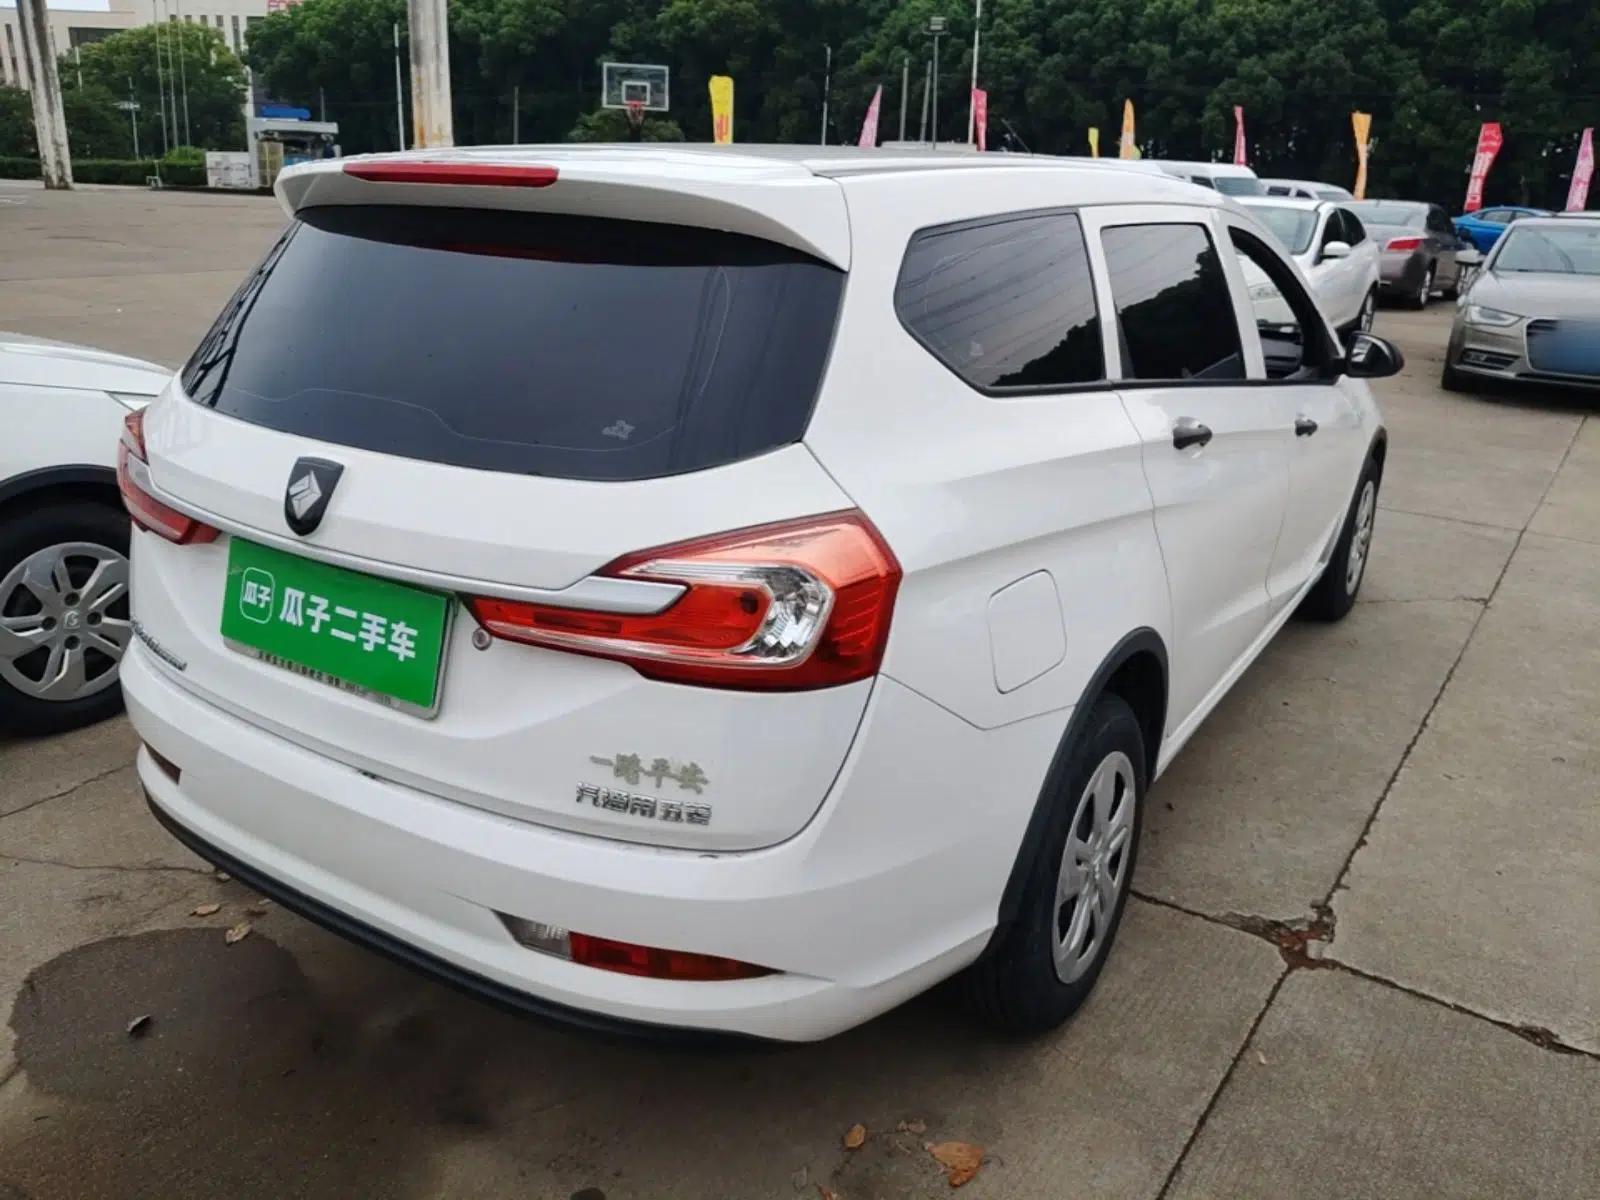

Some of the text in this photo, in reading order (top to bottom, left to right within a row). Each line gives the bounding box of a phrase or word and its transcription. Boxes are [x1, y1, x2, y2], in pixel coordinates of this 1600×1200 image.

[243, 580, 418, 662] 瓜子 瓜子二手车
